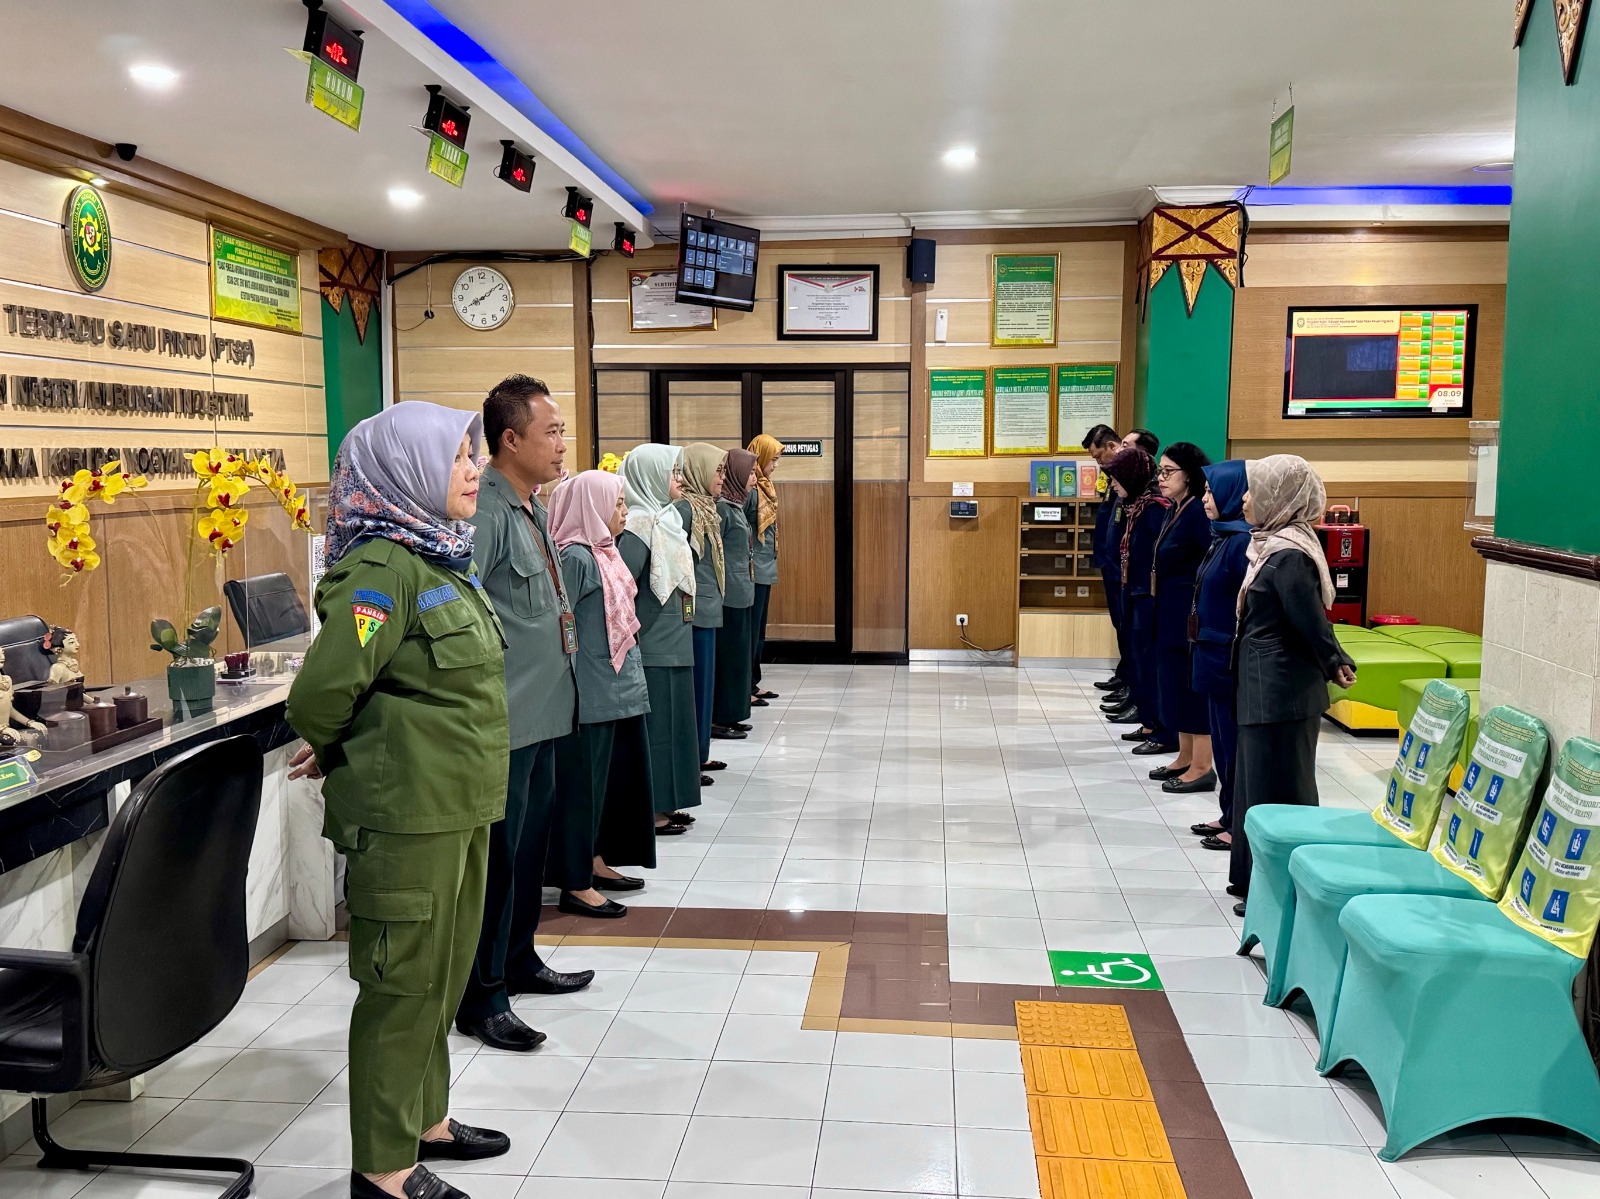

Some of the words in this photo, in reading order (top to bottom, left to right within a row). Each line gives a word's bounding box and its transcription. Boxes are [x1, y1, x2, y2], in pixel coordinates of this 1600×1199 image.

[325, 71, 353, 102] HUKUM
[478, 272, 486, 280] 12
[461, 283, 469, 291] 10
[462, 306, 468, 314] 8
[2, 304, 105, 344] TERPADU
[106, 320, 156, 351] SATU
[158, 328, 207, 358] PINTU
[1437, 390, 1462, 398] 08.09
[797, 444, 819, 453] PETUGAS
[359, 619, 366, 629] P
[369, 622, 376, 632] S
